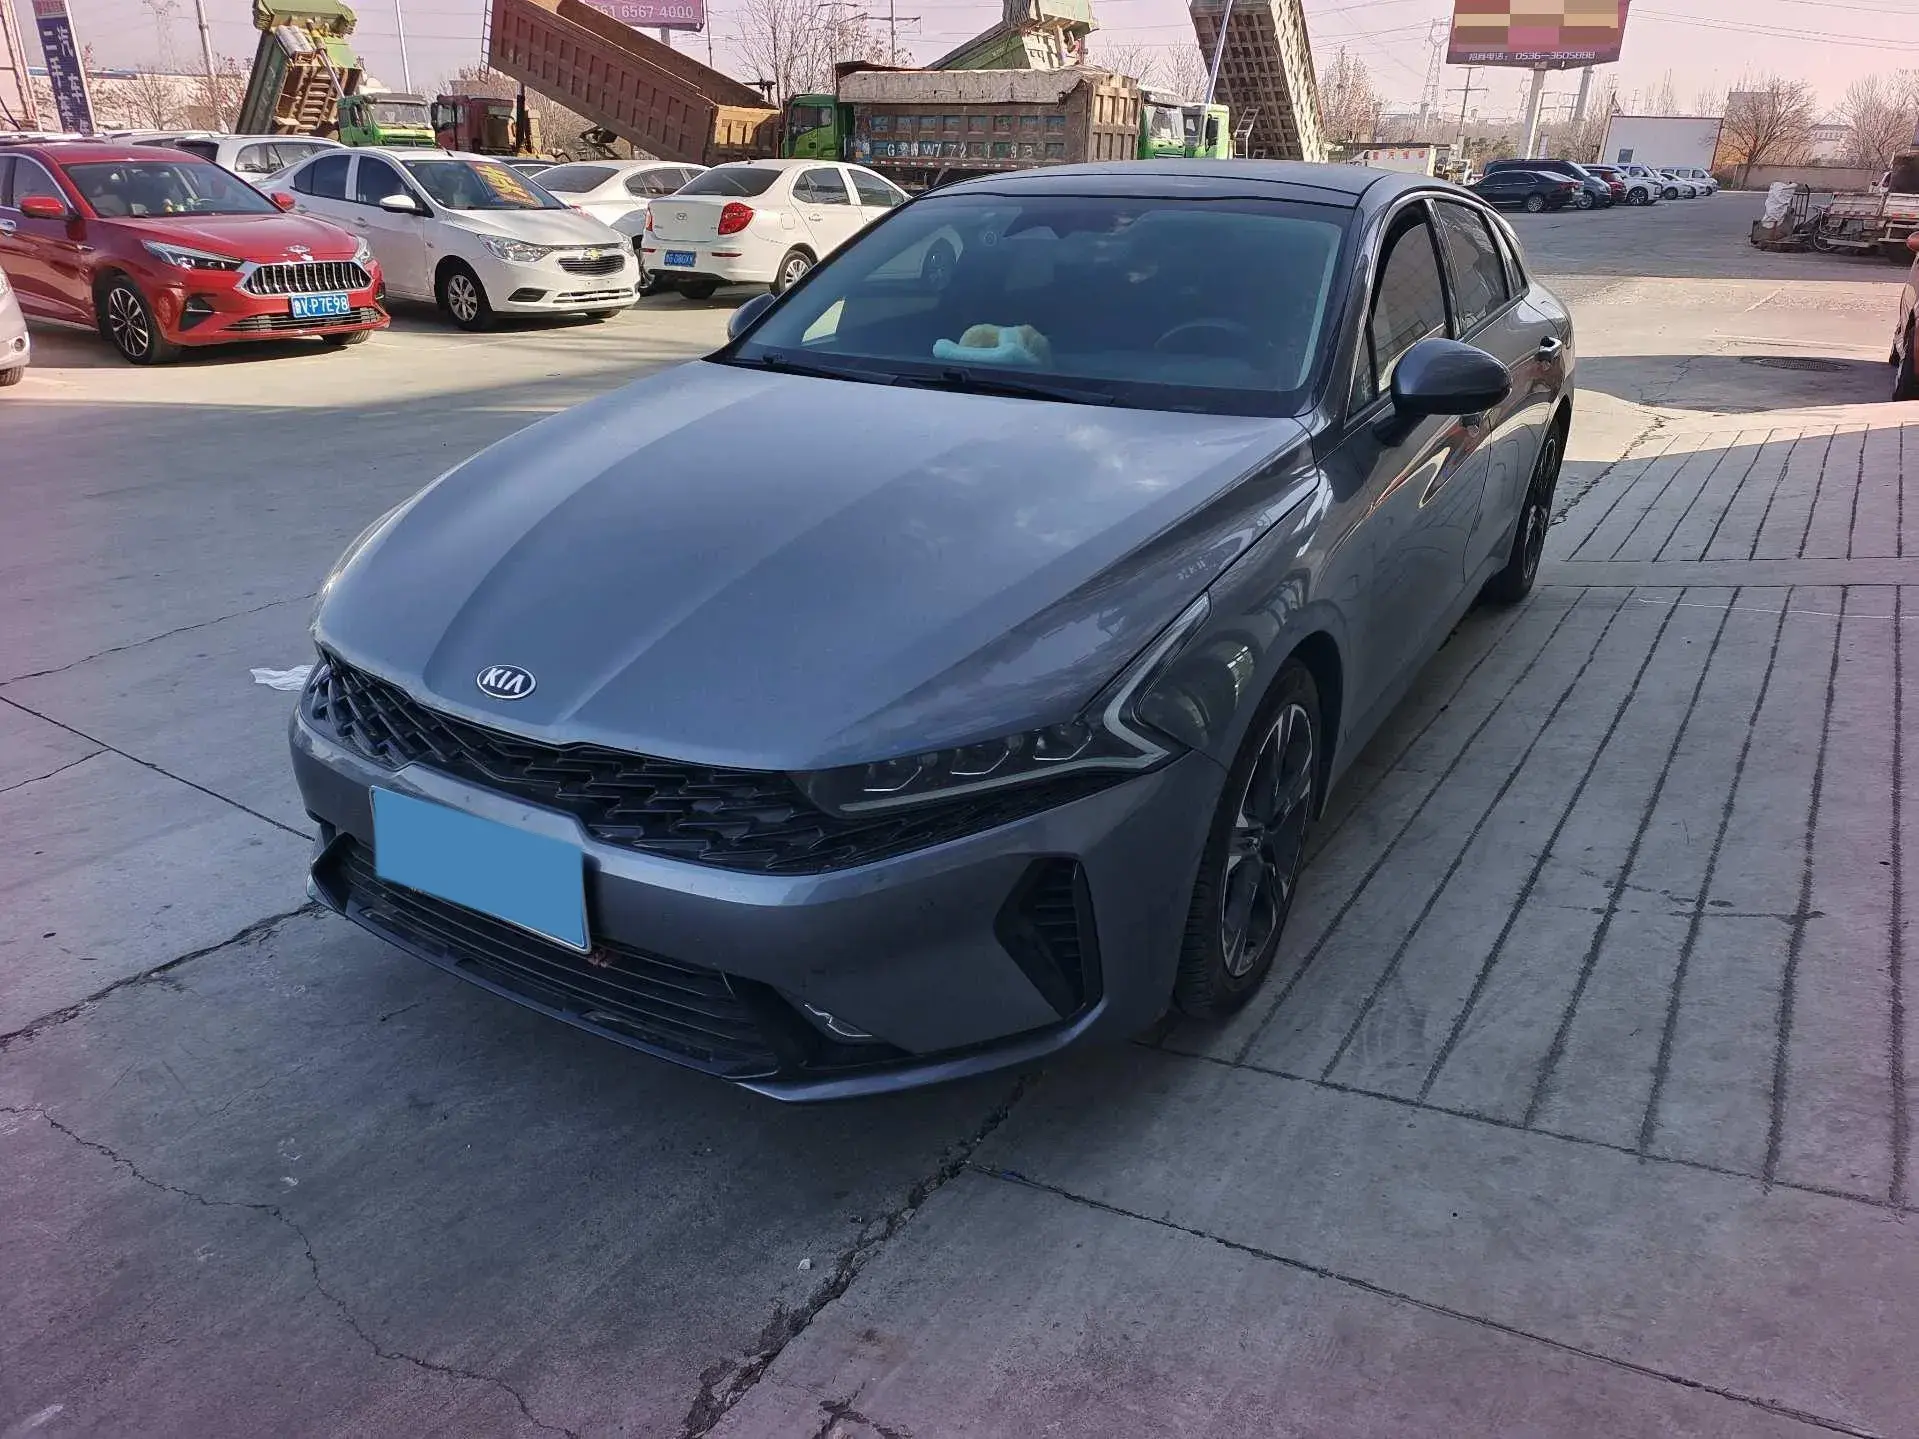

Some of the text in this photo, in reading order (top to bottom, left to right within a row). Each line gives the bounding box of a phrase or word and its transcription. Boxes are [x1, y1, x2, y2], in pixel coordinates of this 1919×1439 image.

[621, 5, 654, 18] 6567
[659, 5, 694, 19] 4000
[481, 667, 526, 694] KIA
